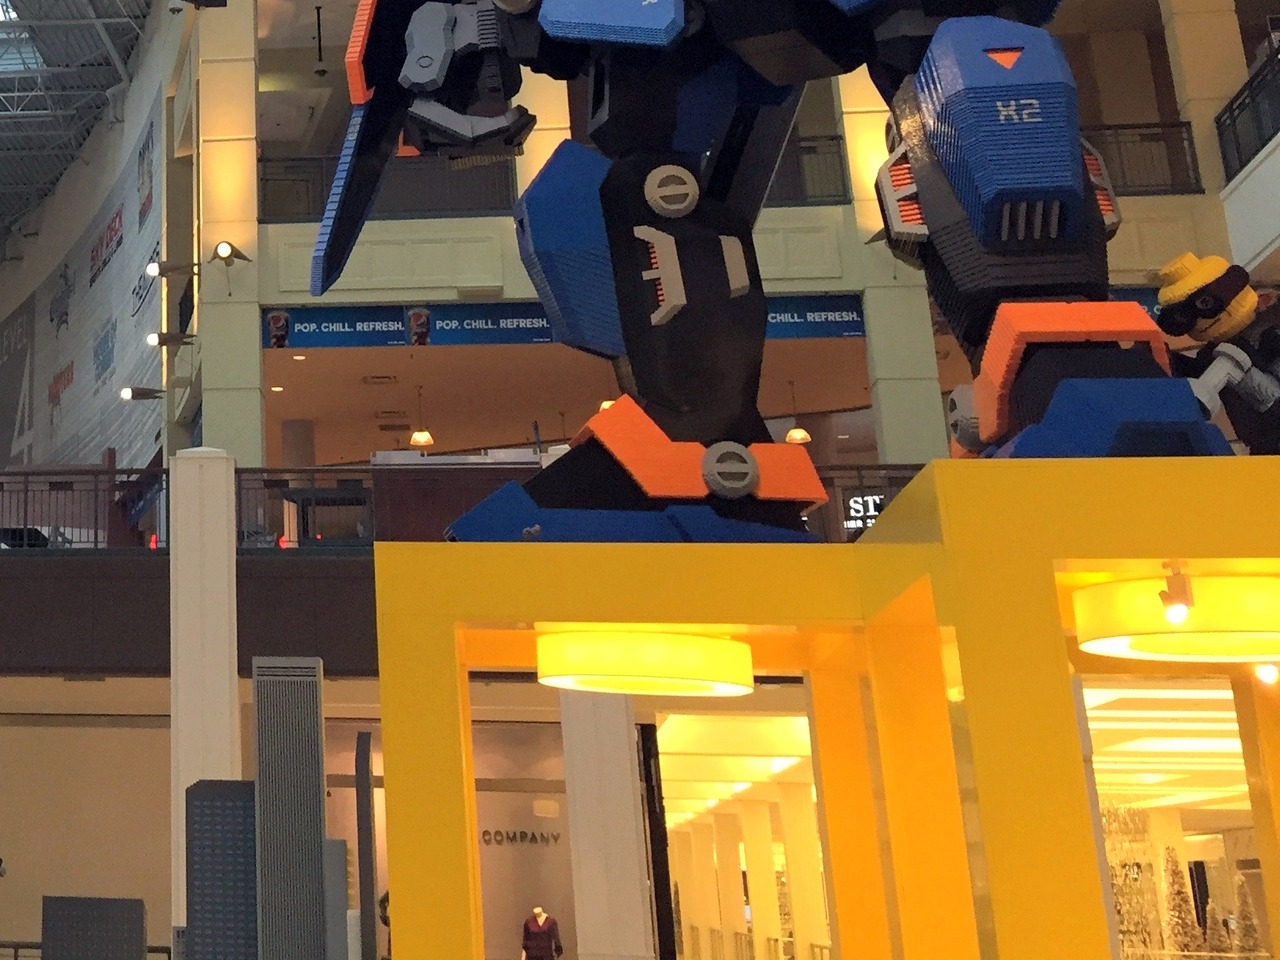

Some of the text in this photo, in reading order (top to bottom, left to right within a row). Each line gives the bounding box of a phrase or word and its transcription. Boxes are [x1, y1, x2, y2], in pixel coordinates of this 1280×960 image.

[767, 311, 861, 322] CHILL. REFRESH.
[294, 321, 405, 333] POP. CHILL. REFRESH.
[435, 318, 550, 330] POP. CHILL. REFRESH.
[482, 829, 561, 847] COMPANY
